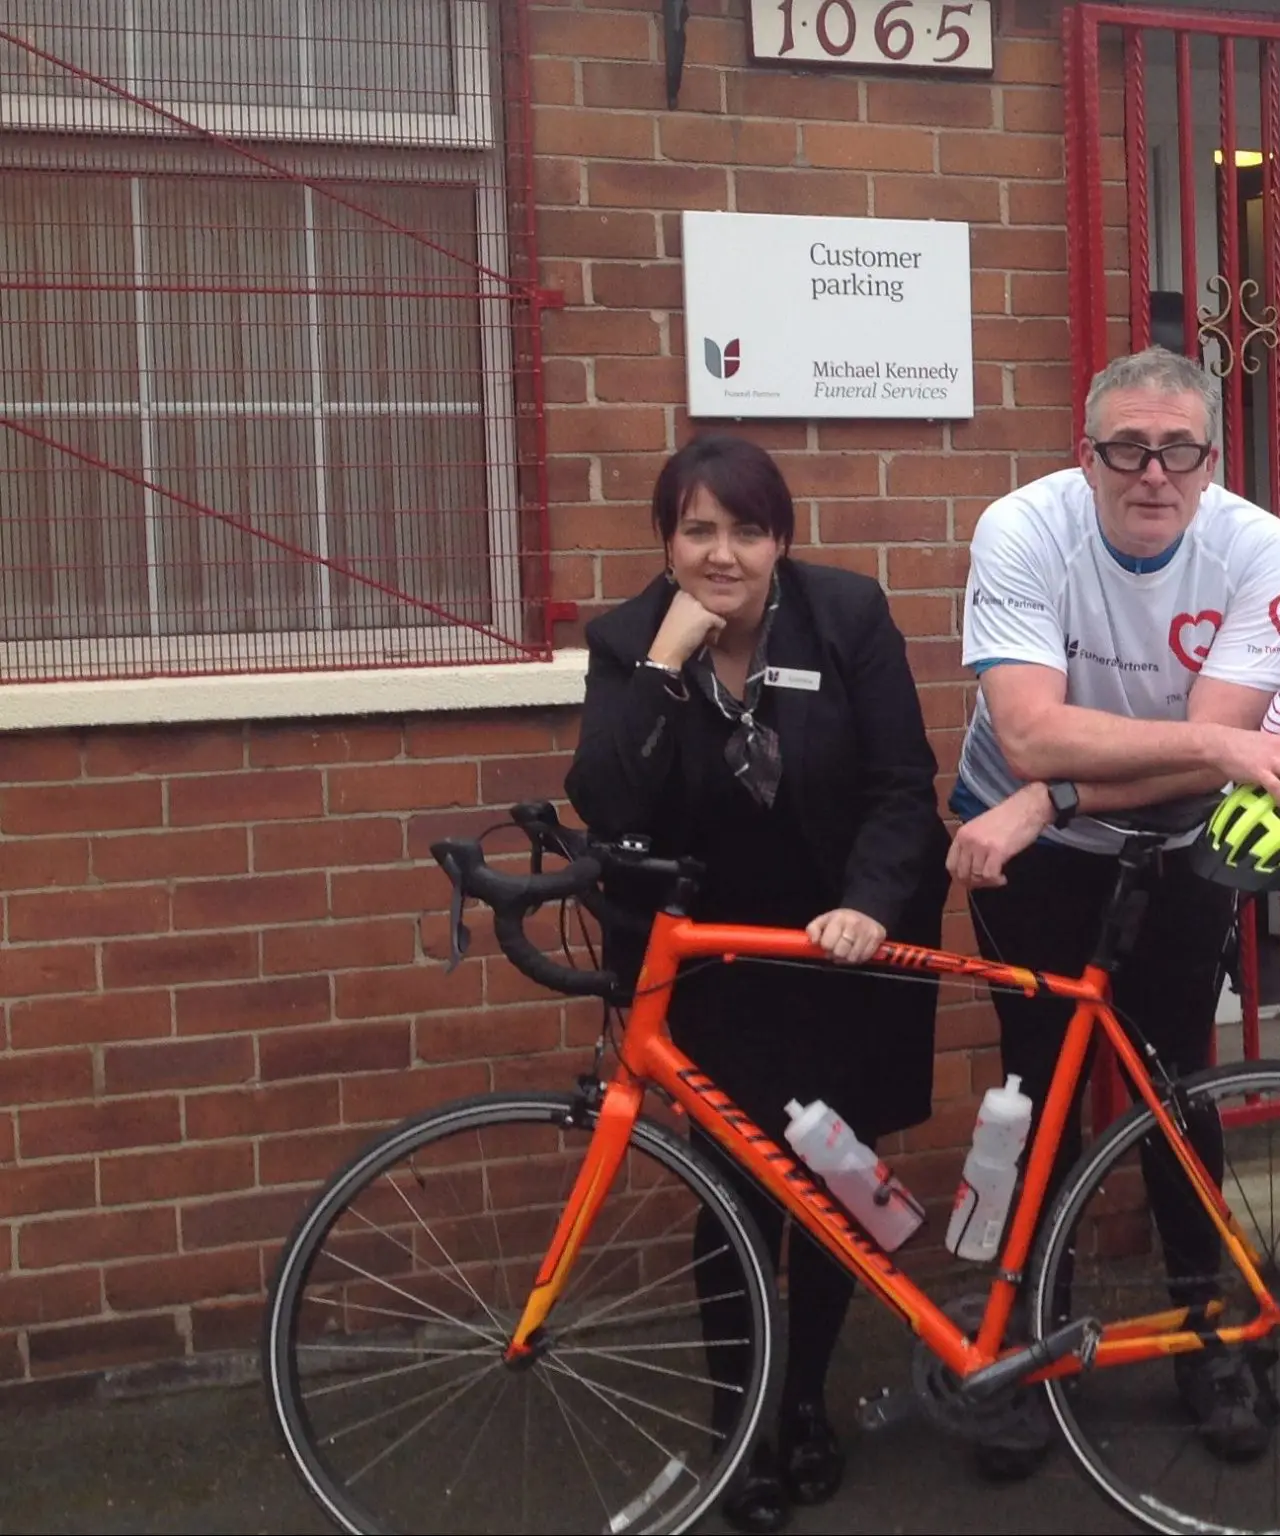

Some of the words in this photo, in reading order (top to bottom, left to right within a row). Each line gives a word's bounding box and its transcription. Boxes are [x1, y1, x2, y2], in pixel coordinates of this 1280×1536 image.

[810, 242, 922, 269] Customer
[811, 273, 905, 302] parking
[813, 360, 880, 380] Michael
[885, 361, 959, 384] Kennedy
[813, 382, 877, 400] Funeral
[881, 382, 948, 400] Services
[1007, 597, 1045, 612] Partners
